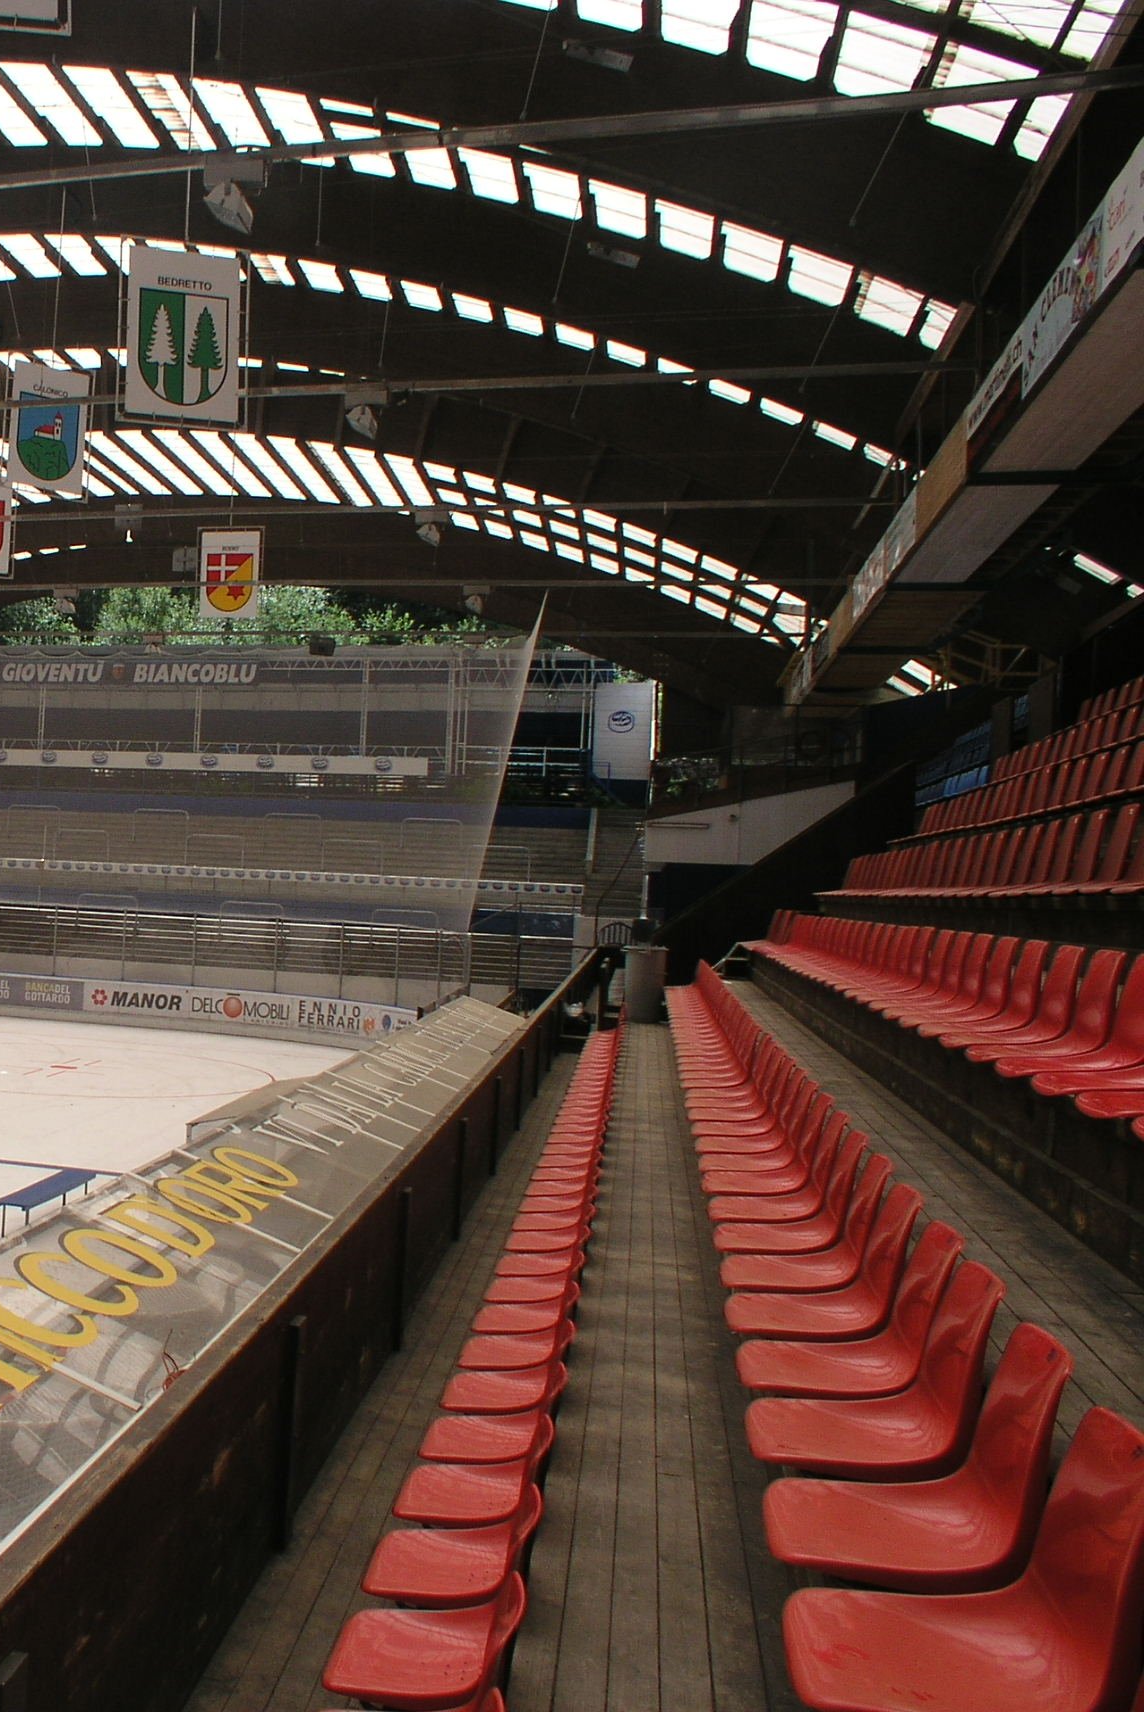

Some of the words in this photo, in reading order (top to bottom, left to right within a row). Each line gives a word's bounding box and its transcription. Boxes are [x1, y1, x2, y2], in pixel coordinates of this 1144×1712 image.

[158, 276, 212, 291] BEDRETTO
[25, 991, 71, 1004] GOTTARDO
[111, 991, 183, 1011] MANOR
[299, 999, 361, 1018] ENNIO
[298, 1011, 360, 1031] FERRARI
